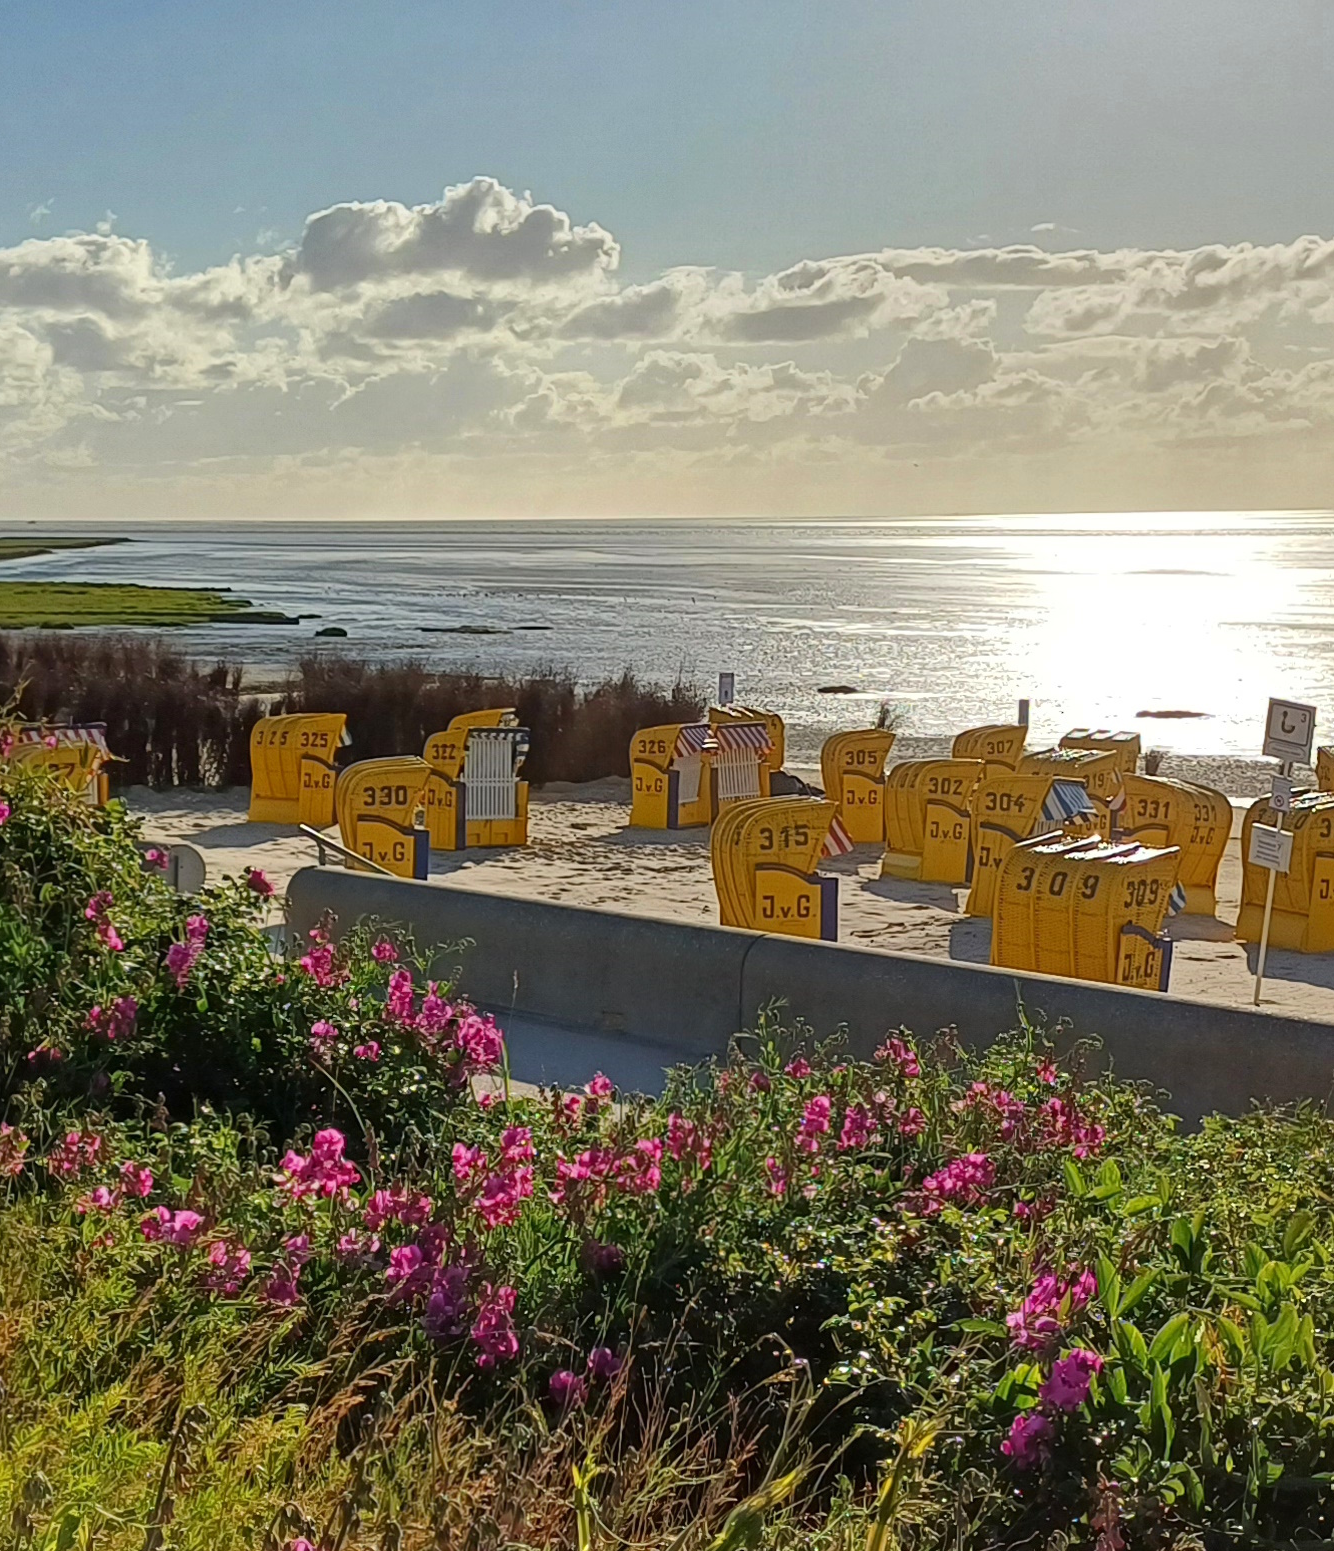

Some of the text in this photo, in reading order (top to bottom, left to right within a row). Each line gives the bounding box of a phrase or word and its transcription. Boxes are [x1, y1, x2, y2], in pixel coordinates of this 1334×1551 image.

[1300, 713, 1307, 723] 3
[301, 732, 328, 747] 325
[638, 740, 666, 754] 326
[987, 740, 1014, 754] 307
[432, 743, 456, 760] 322
[845, 750, 877, 766] 305
[363, 785, 407, 806] 330
[928, 777, 963, 796] 302
[985, 791, 1025, 812] 304
[1137, 799, 1171, 818] 331
[759, 823, 810, 850] 315
[1123, 878, 1160, 909] 309
